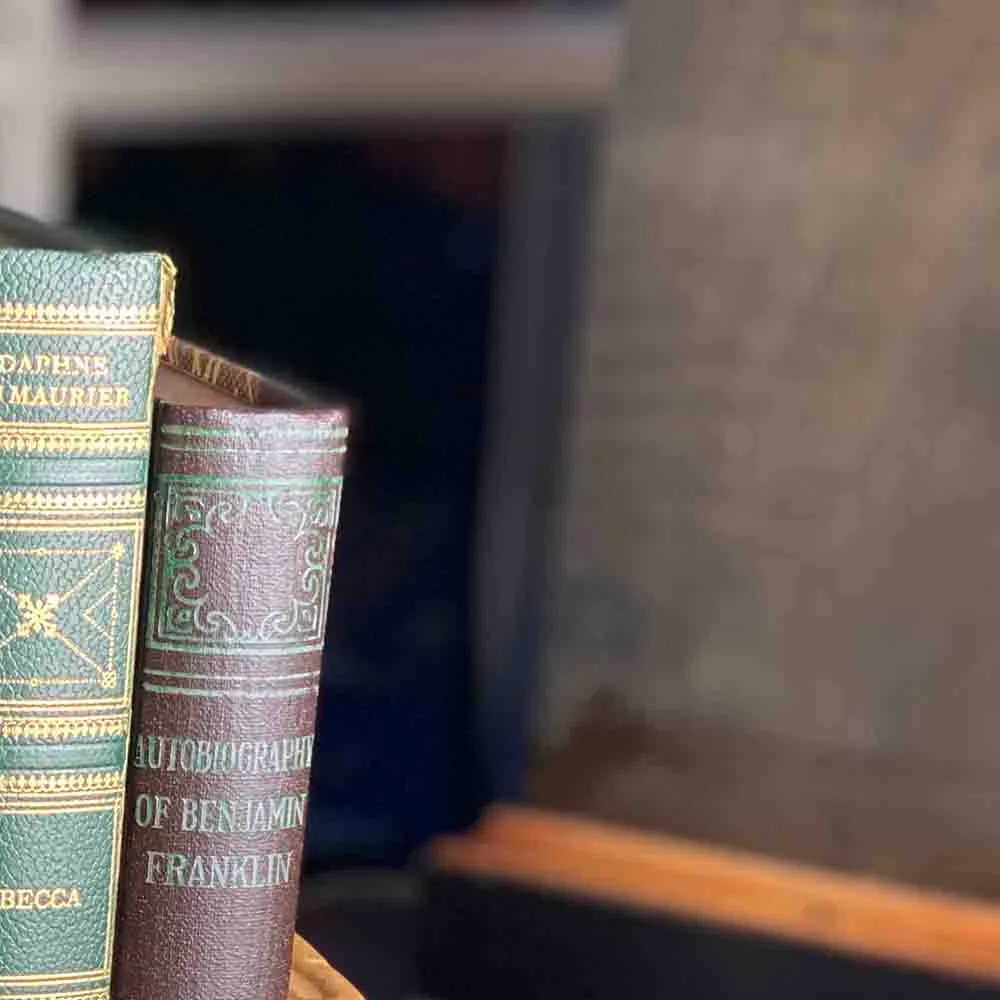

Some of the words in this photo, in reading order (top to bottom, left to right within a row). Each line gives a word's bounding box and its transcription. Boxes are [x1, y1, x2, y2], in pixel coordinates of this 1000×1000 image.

[8, 385, 131, 407] MAURIER
[135, 794, 169, 829] OF
[181, 793, 308, 832] BENJAMIN
[145, 850, 293, 888] FRANKLIN
